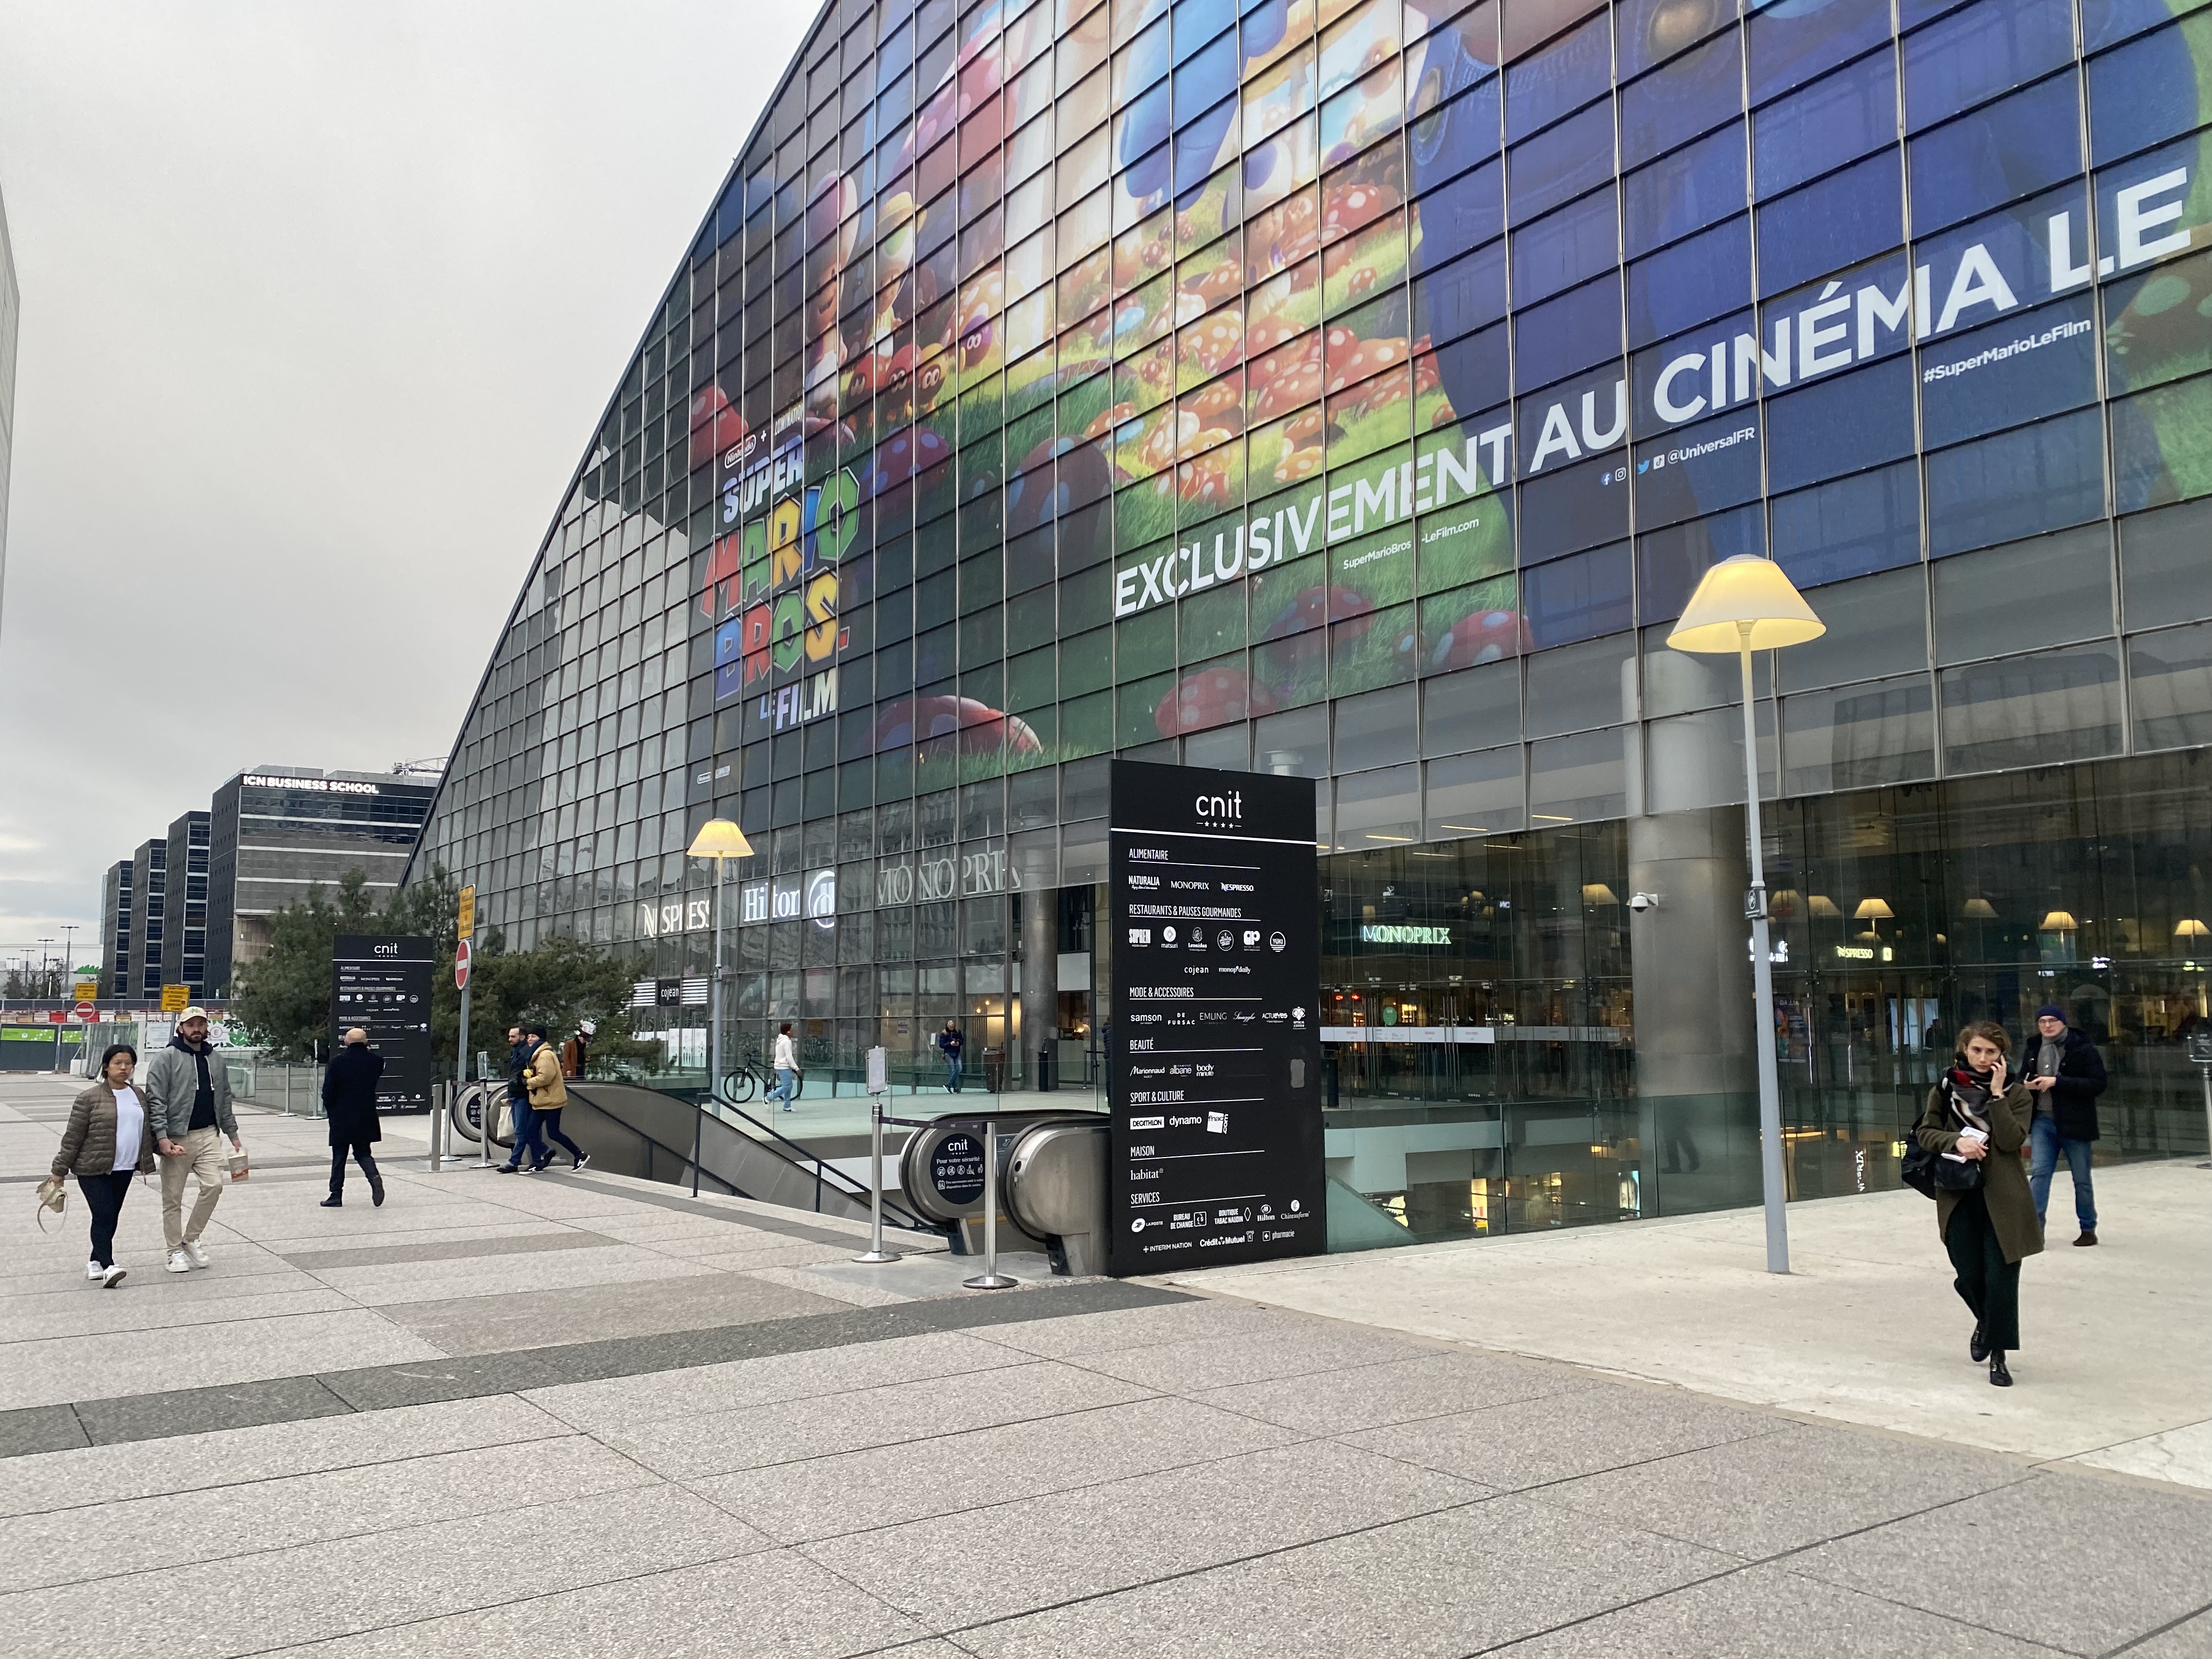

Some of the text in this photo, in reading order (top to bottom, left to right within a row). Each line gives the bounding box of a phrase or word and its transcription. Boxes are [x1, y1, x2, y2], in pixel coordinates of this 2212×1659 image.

[1923, 318, 2091, 383] #SuperMarioLeFilm
[1115, 167, 2191, 617] EXCLUSIVEMENT AU CINÉMA LE
[1667, 426, 1755, 466] @UniversalFR
[723, 435, 803, 523] SUPER
[701, 466, 860, 619] MARIO
[776, 667, 837, 730] FILM
[243, 775, 380, 794] ICN BUSINESS SCHOOL
[1196, 791, 1242, 819] cnit
[1129, 848, 1169, 860] ALIMENTAIRE
[1128, 875, 1160, 887] NATURALIA
[1171, 881, 1209, 890] MONOPRIX
[1221, 882, 1254, 891] NESPRESSO
[1129, 904, 1241, 917] RESTAURANTS & PAUSES GOURMANDES
[1362, 926, 1452, 944] MONOPRIX
[374, 943, 398, 954] cnit
[1184, 964, 1209, 975] cojean
[661, 986, 679, 1001] cojean
[1130, 987, 1194, 997] MODE & ACCESSOIRES
[1130, 1014, 1162, 1022] samson
[1199, 1012, 1227, 1020] EMLING
[1130, 1037, 1154, 1051] BEAUTÉ
[1130, 1065, 1165, 1077] Marionnaud
[1197, 1063, 1215, 1072] body
[1130, 1090, 1184, 1103] SPORT & CULTURE
[1169, 1116, 1202, 1127] dynamo
[948, 1139, 968, 1152] cnit
[1130, 1146, 1155, 1157] MAISON
[1130, 1169, 1159, 1181] habitat
[1131, 1192, 1160, 1204] SERVICES
[1173, 1213, 1190, 1221] BUREAU
[1218, 1208, 1239, 1216] BOUTIQUE
[1176, 1221, 1194, 1229] CHANGE
[1200, 1235, 1245, 1247] Crédit Mutuel
[1272, 1230, 1295, 1240] pharmacie
